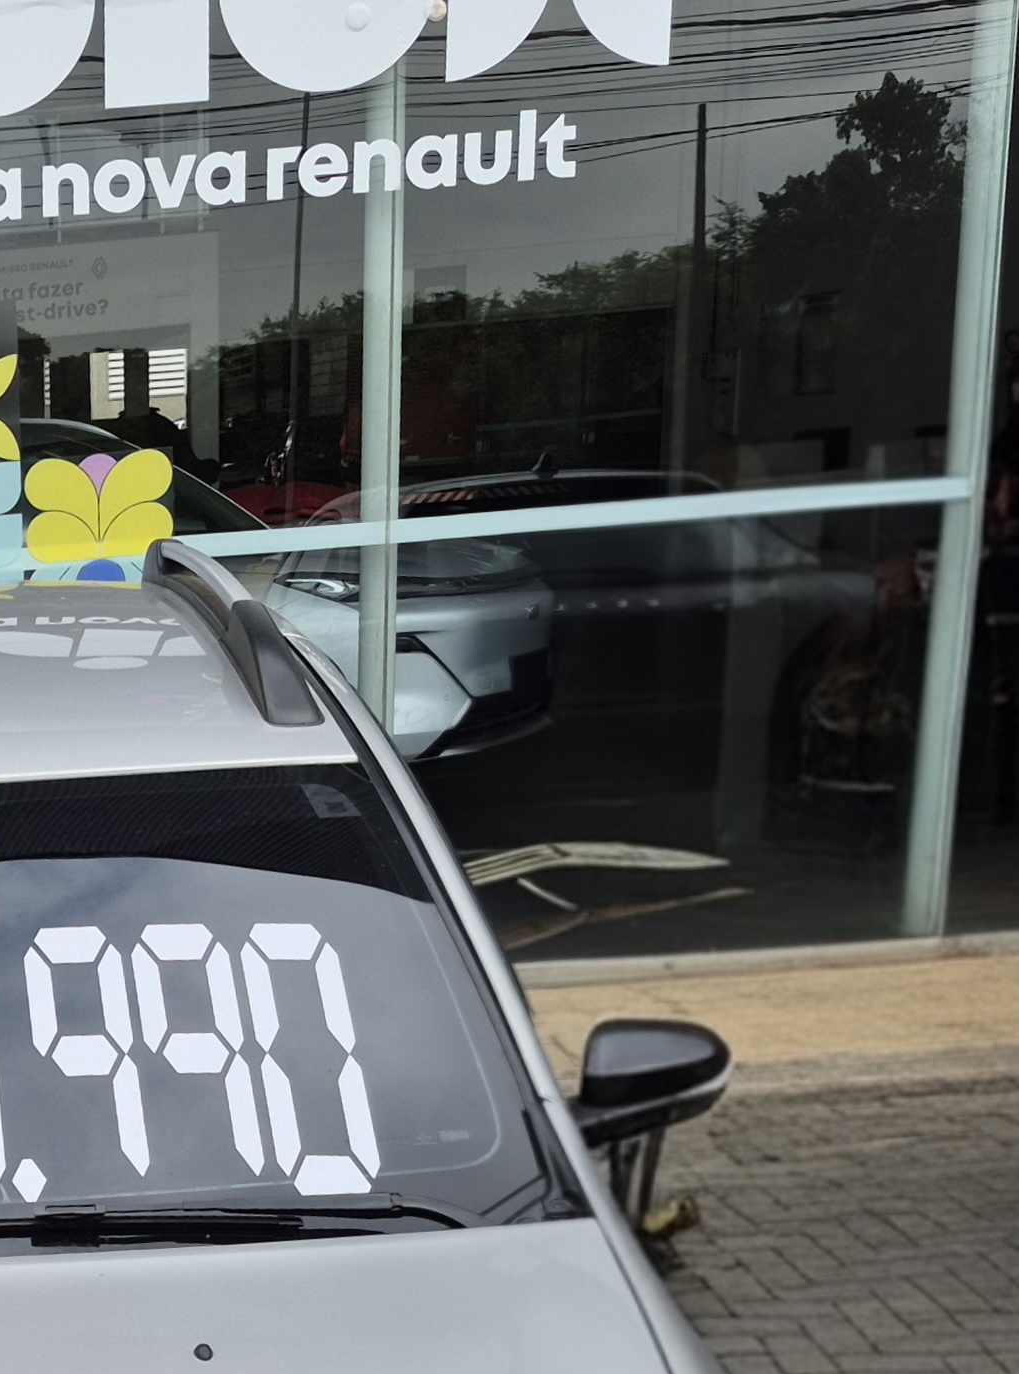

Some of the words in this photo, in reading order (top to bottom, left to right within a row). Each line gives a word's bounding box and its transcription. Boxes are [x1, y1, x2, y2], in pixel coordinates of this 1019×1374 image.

[41, 150, 246, 218] nova
[266, 109, 577, 202] renault
[30, 258, 74, 271] RENAULT
[27, 281, 84, 300] fazer
[17, 298, 109, 323] st-drive?
